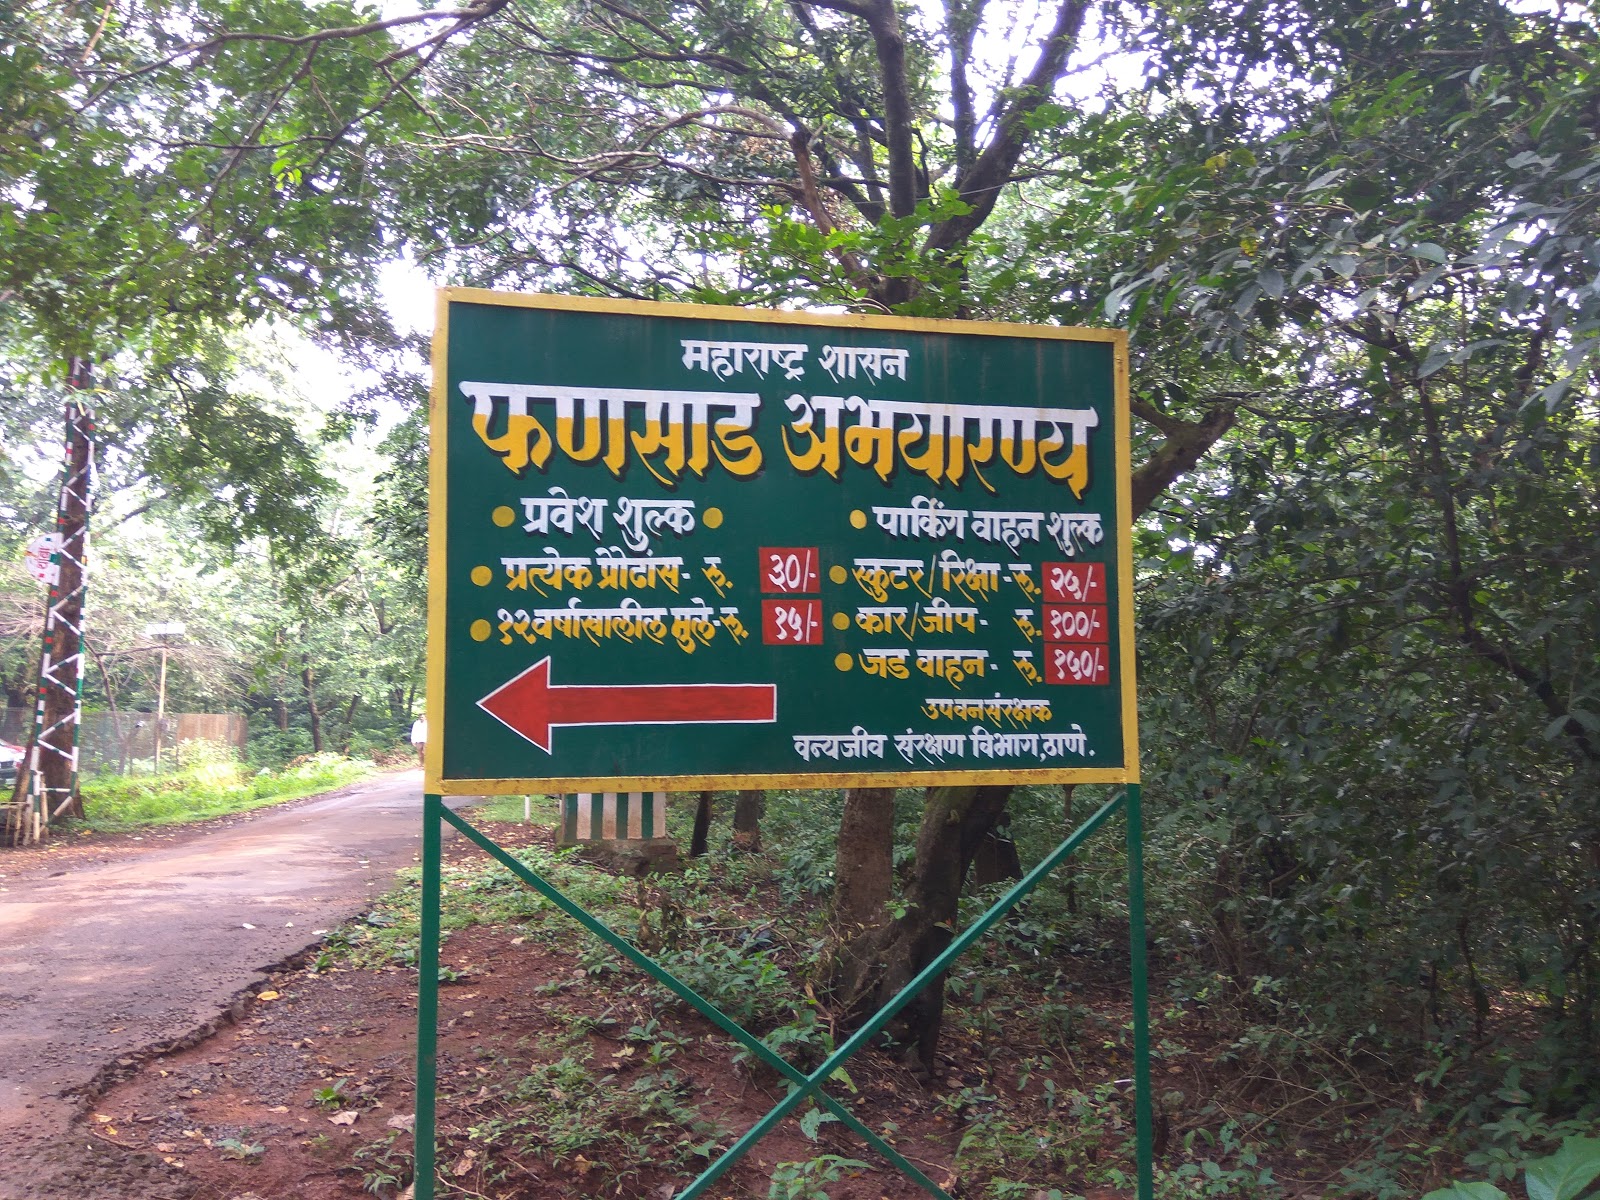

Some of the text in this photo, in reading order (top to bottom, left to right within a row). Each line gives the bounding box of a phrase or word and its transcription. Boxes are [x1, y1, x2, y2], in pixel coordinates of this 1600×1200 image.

[680, 340, 910, 386] महाराष्ट्र शासन
[458, 380, 1099, 500] फणसाड अभयारण्य
[519, 486, 696, 552] प्रवेश शुल्क
[871, 495, 1104, 557] पार्किंग वाहन शुल्क
[500, 547, 593, 598] प्रत्येक
[858, 649, 910, 679] जड
[792, 725, 888, 762] वन्यजीव
[893, 728, 967, 765] संरक्षण
